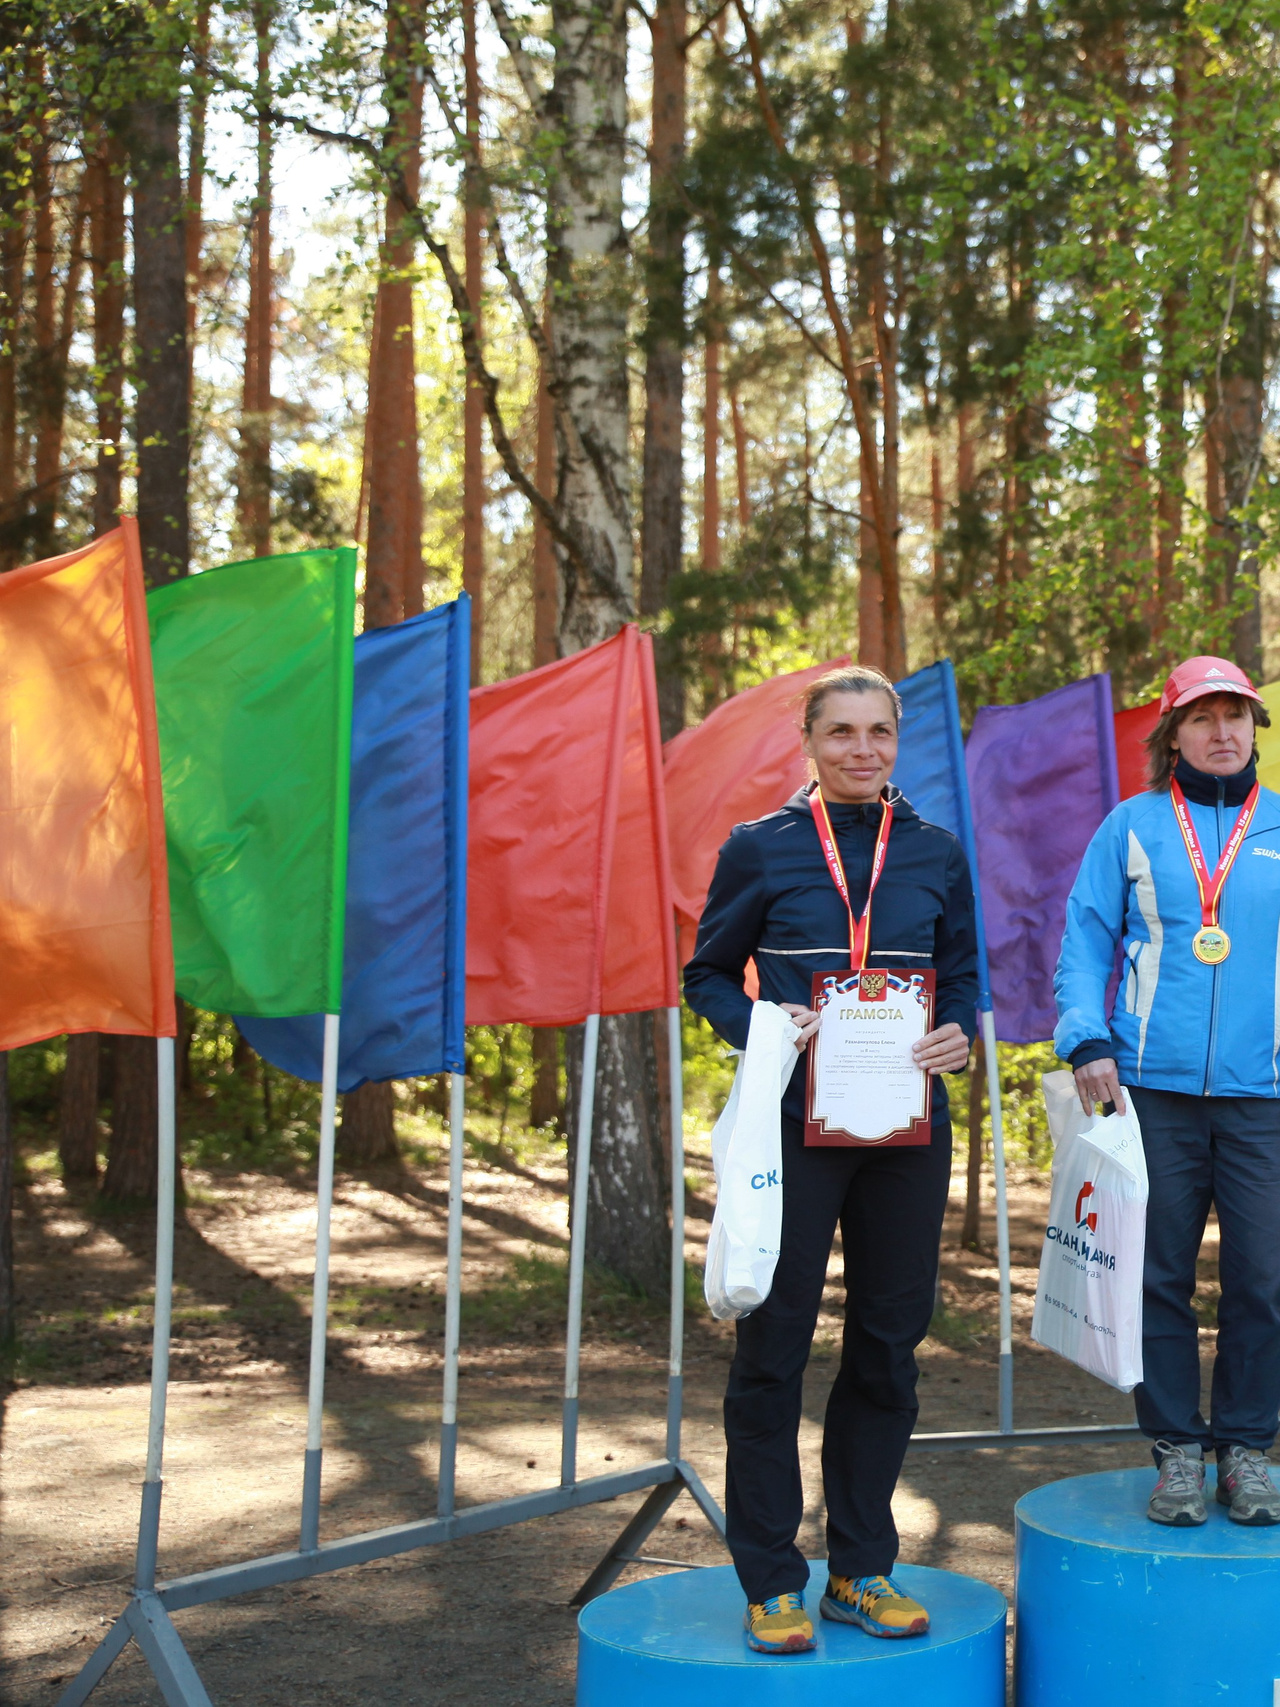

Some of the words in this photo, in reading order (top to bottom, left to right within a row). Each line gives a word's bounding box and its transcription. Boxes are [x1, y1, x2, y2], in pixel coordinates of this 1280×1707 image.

[1242, 810, 1250, 819] лет
[1238, 818, 1245, 827] 15
[1229, 828, 1242, 848] Марья
[1193, 850, 1200, 858] 15
[1227, 846, 1234, 856] да
[1219, 853, 1230, 871] Иван
[839, 1008, 904, 1020] ГРАМОТА
[750, 1169, 783, 1190] СК
